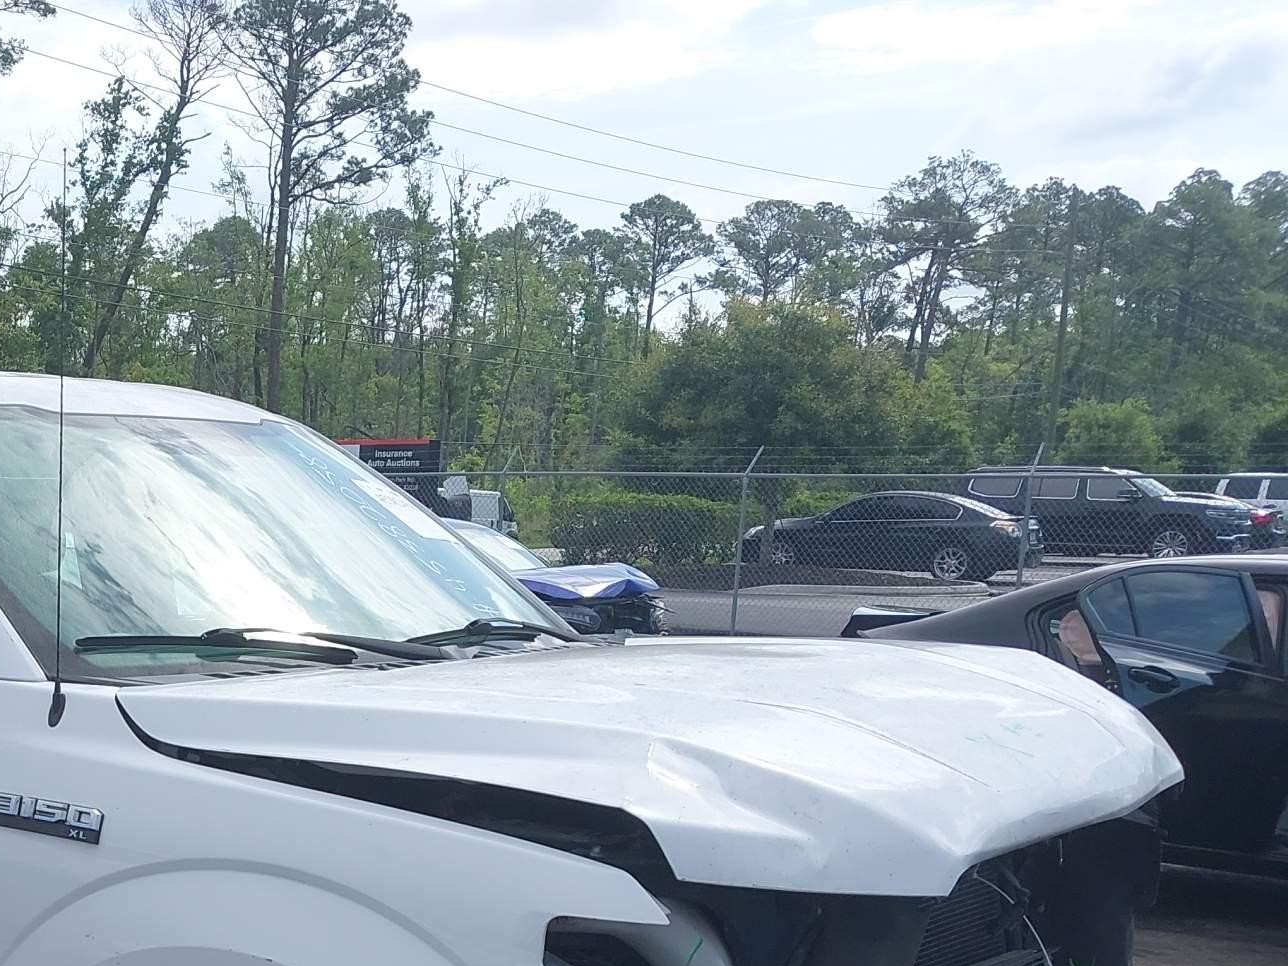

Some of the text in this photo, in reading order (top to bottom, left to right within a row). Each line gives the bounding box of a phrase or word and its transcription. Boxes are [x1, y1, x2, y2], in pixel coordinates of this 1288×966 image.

[375, 449, 413, 458] Insurance
[368, 458, 421, 467] Auto Auctions
[68, 828, 87, 840] XL
